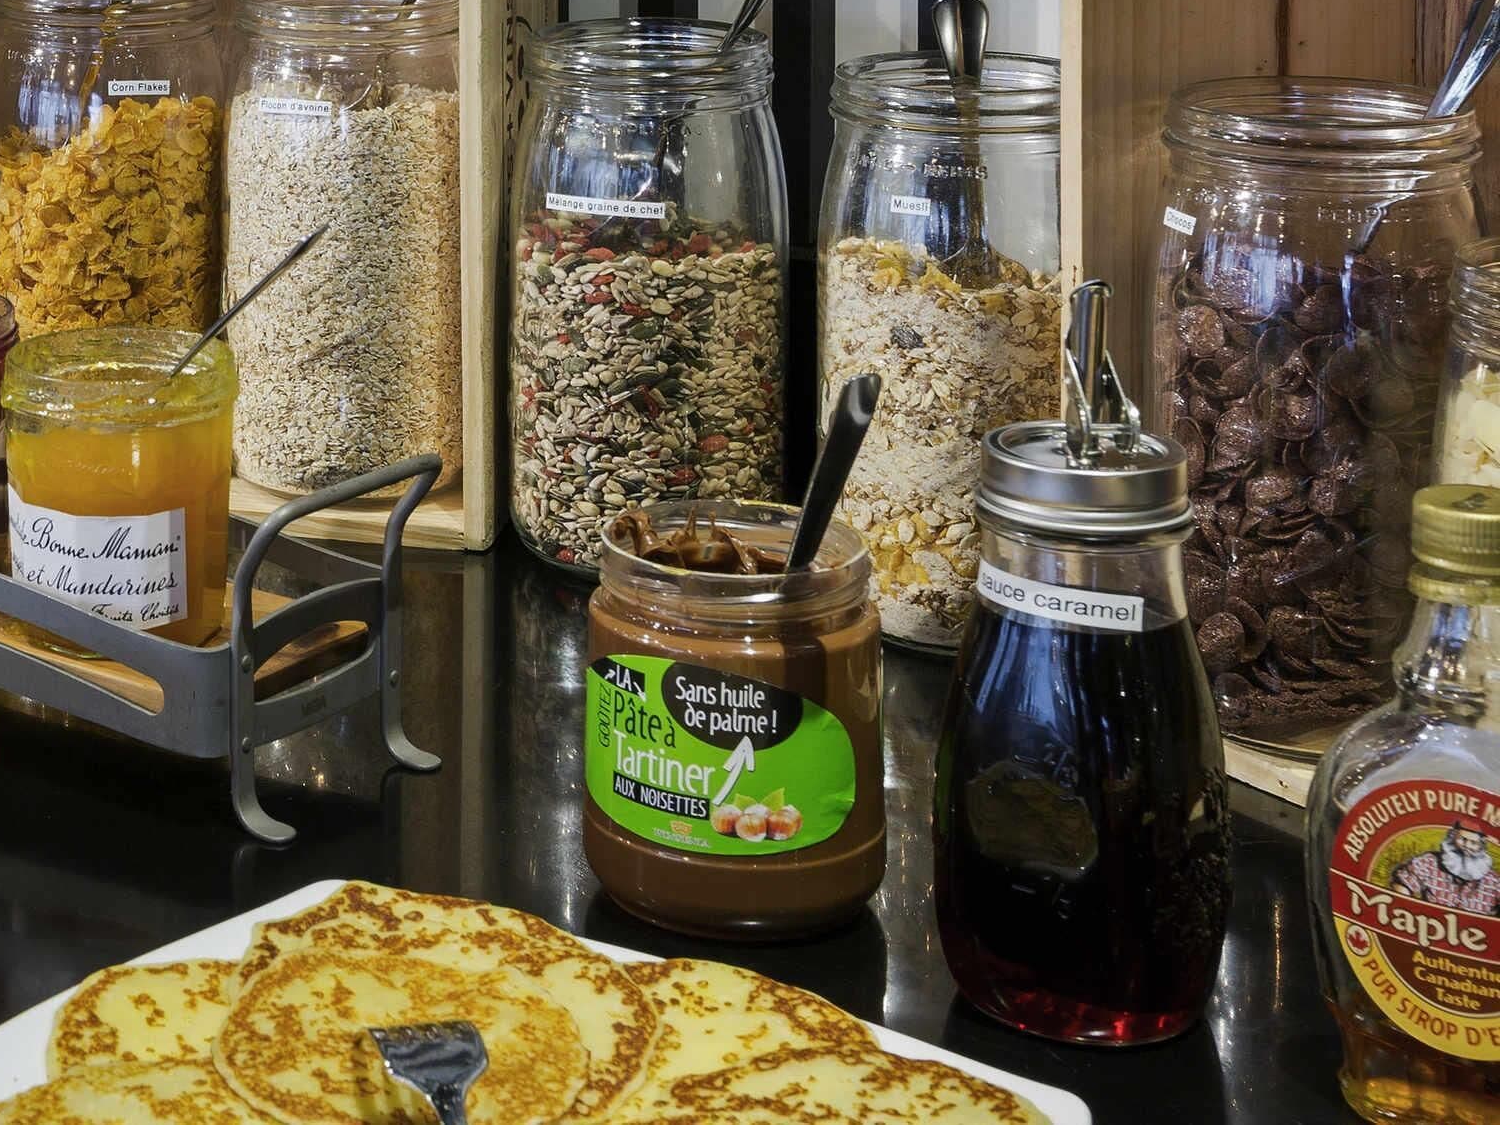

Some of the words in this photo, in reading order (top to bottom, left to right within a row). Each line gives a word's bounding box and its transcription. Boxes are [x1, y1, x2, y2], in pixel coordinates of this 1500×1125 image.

[111, 82, 135, 92] Corn
[137, 82, 168, 92] Flakes
[623, 204, 636, 214] de
[892, 199, 929, 212] Muesli
[30, 517, 89, 560] Bonne
[92, 525, 179, 561] Maman
[27, 564, 46, 586] et
[46, 565, 179, 596] Mandarines
[981, 572, 1026, 602] sauce
[1033, 593, 1136, 621] caramel
[616, 664, 632, 691] LA
[675, 675, 717, 705] Sans
[720, 681, 766, 709] huile
[613, 690, 662, 743] Pâte
[663, 717, 676, 749] à
[684, 701, 707, 729] de
[709, 707, 769, 736] palme
[613, 729, 716, 796] Tartiner
[614, 776, 636, 800] AUX
[639, 786, 708, 818] NOISETTES
[1342, 790, 1421, 863] ABSOLUTELY
[1423, 789, 1481, 818] PURE
[1346, 880, 1488, 952] Maple
[1362, 958, 1398, 1002] PUR
[1396, 997, 1459, 1041] SIROP
[1434, 986, 1482, 1011] Taste
